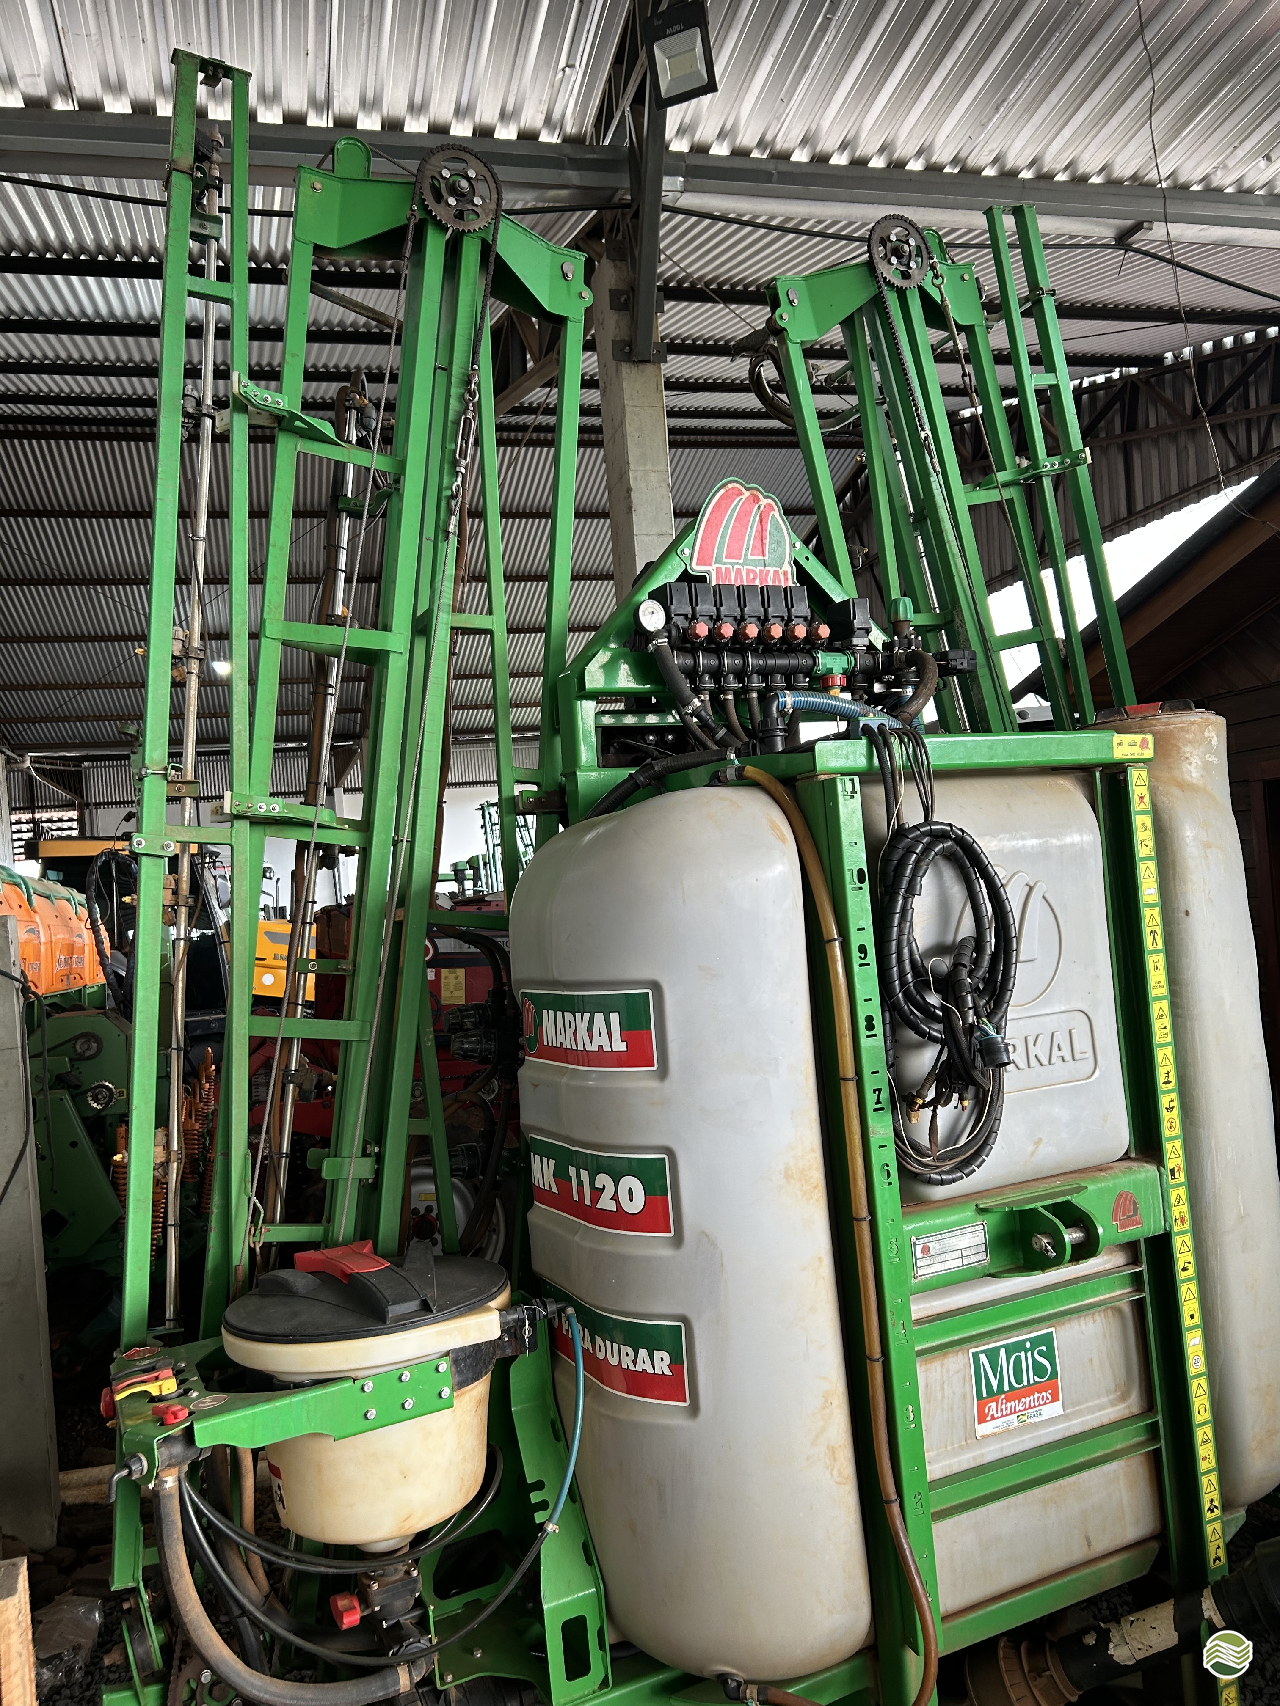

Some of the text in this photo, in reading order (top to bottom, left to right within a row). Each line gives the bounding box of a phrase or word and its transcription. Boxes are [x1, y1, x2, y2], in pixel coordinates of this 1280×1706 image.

[848, 867, 867, 885] 10
[857, 943, 868, 961] 9
[542, 1009, 628, 1052] MARKAL
[864, 1014, 875, 1032] 8
[1004, 1028, 1089, 1073] RKAL
[872, 1087, 883, 1105] 7
[568, 1164, 646, 1214] 1120
[595, 1335, 673, 1376] DURAR
[979, 1341, 1052, 1398] Mais
[984, 1389, 1052, 1421] Alimentos
